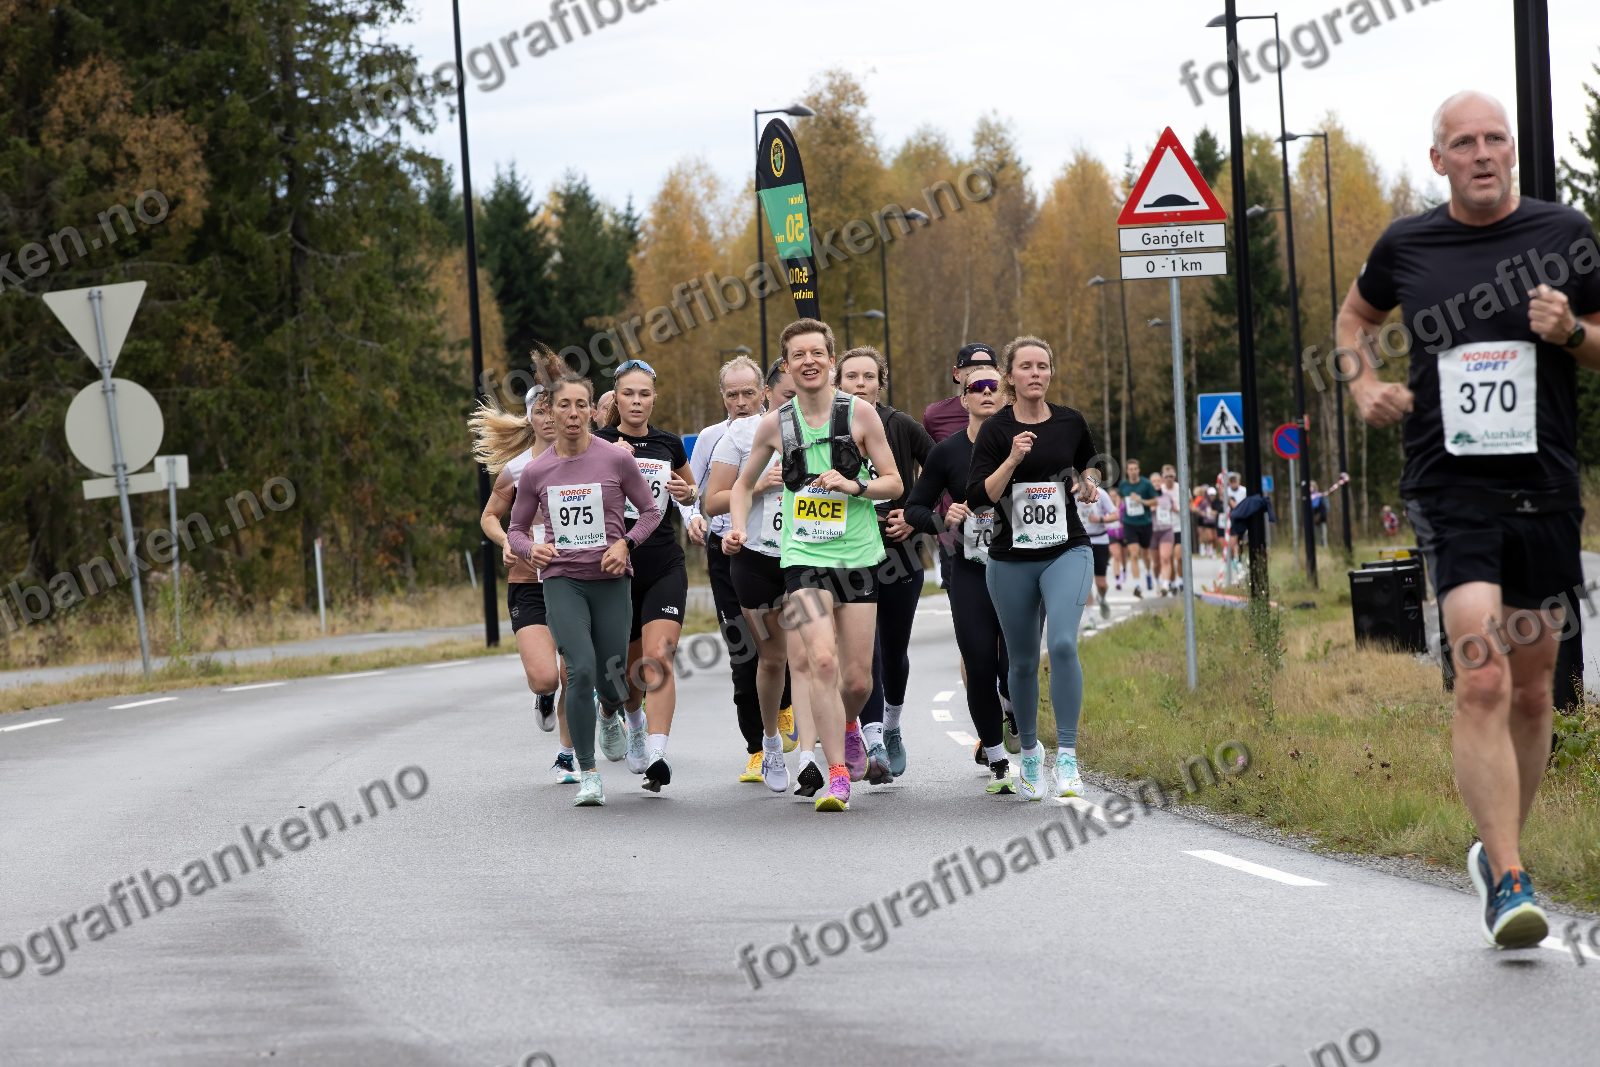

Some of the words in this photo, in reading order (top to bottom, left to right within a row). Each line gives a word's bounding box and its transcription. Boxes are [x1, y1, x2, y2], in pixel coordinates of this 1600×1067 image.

[1141, 230, 1205, 247] Gangfelt
[1146, 260, 1156, 273] 0
[1171, 260, 1176, 272] 1
[1461, 350, 1519, 361] NORGES
[1466, 361, 1509, 372] LØPET
[1459, 380, 1517, 414] 370
[559, 488, 592, 497] NORGES
[797, 499, 842, 518] PACE
[1022, 504, 1057, 525] 808
[559, 506, 594, 527] 975
[1034, 532, 1066, 541] Aurskog
